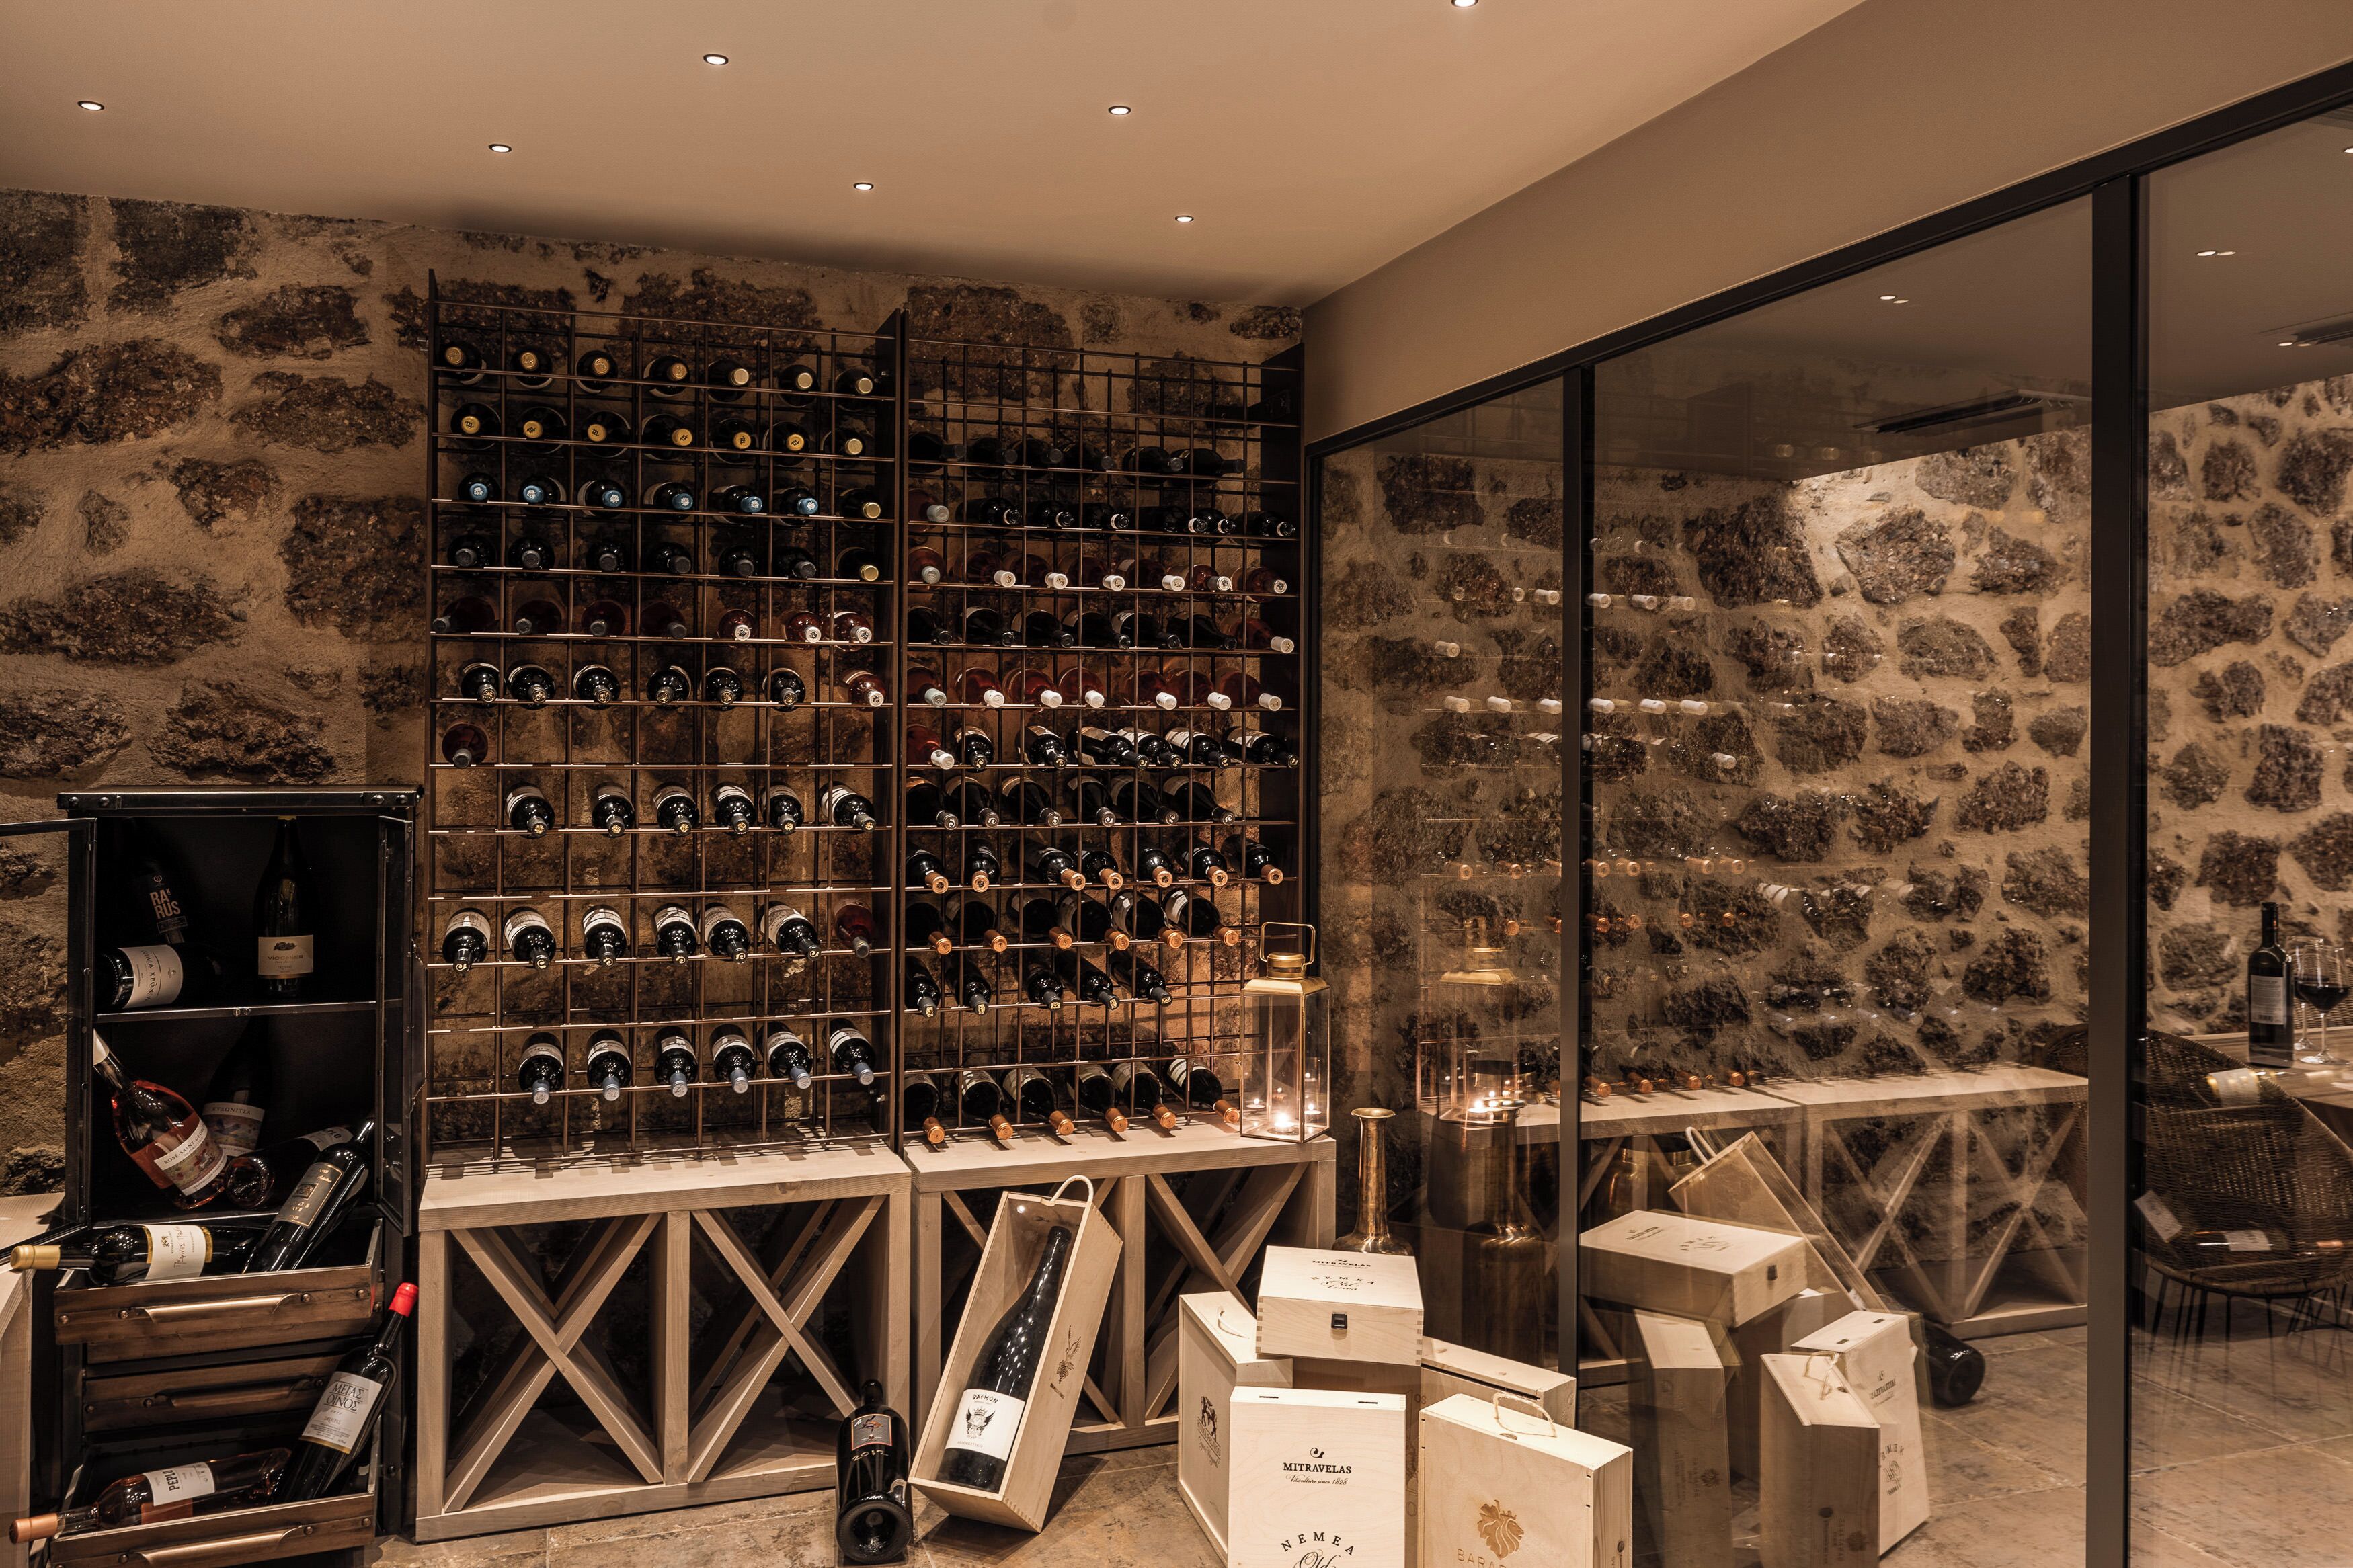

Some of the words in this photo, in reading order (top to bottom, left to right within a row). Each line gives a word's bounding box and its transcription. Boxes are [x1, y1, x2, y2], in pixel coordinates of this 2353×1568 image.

[332, 1383, 365, 1400] ΜΕΓΑΣ
[973, 1393, 998, 1403] DAEMON
[327, 1393, 360, 1411] ΟΙΝΟΣ
[1283, 1462, 1352, 1474] MITRAVELAS
[162, 1469, 180, 1491] PEPLO
[1332, 1477, 1349, 1485] 1828
[1281, 1532, 1354, 1556] NEMEA
